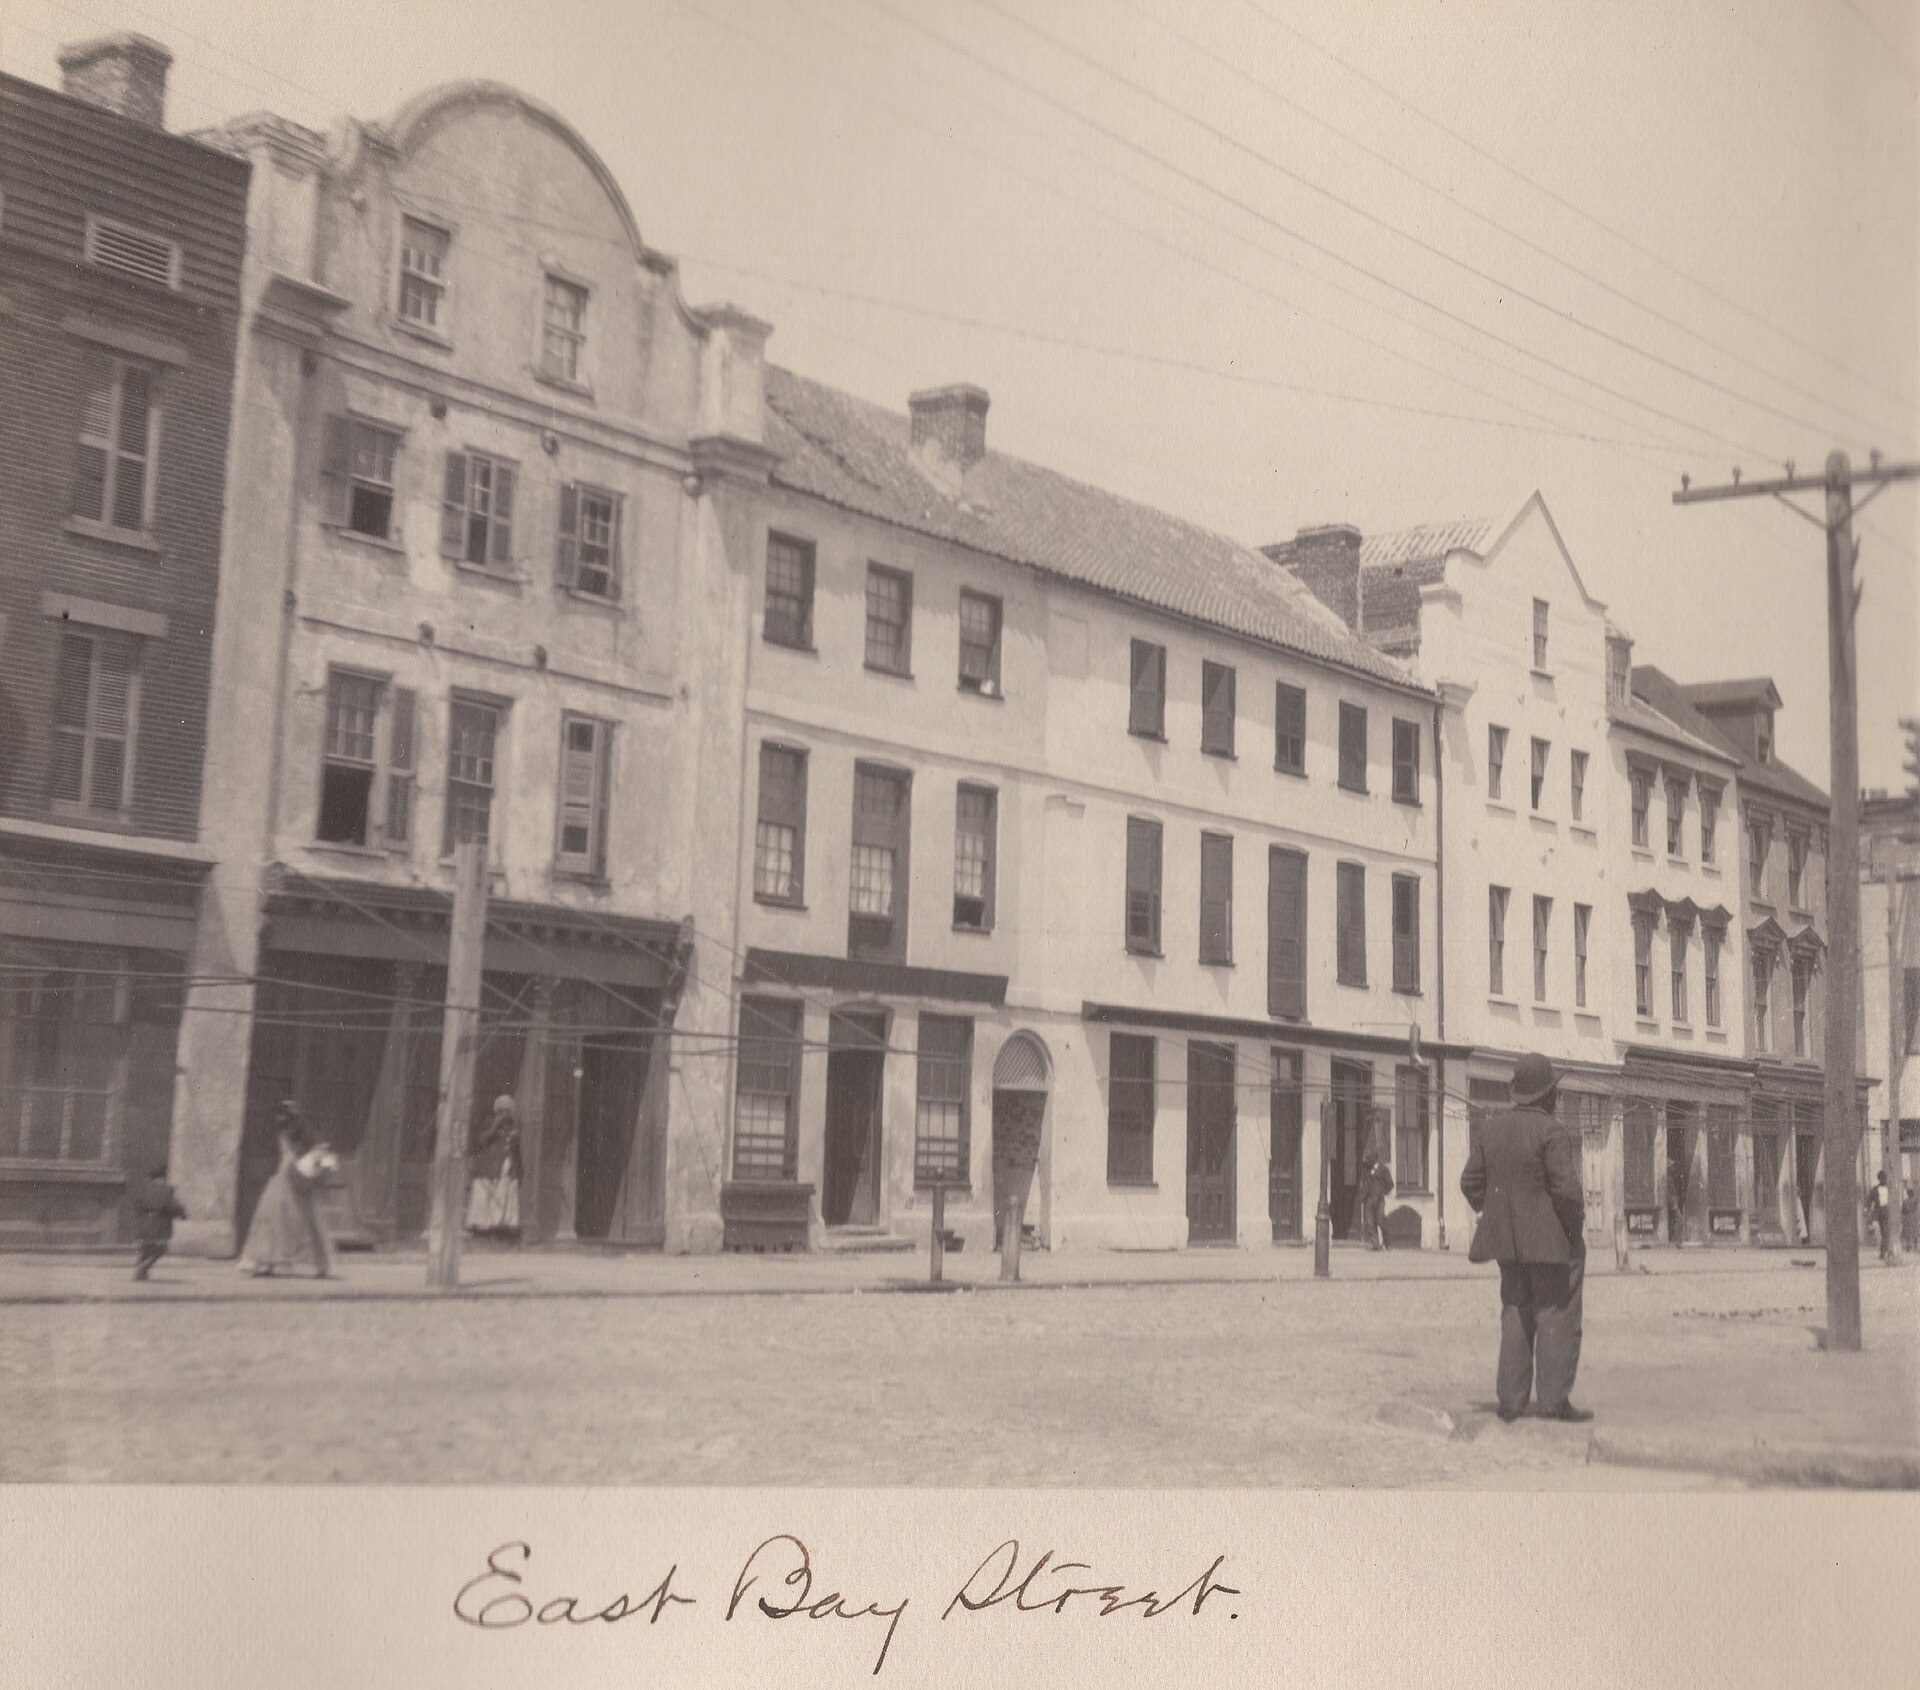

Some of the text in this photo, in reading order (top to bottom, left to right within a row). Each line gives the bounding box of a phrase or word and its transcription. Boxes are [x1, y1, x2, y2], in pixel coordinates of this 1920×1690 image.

[453, 1534, 1242, 1676] East Bay Street.
